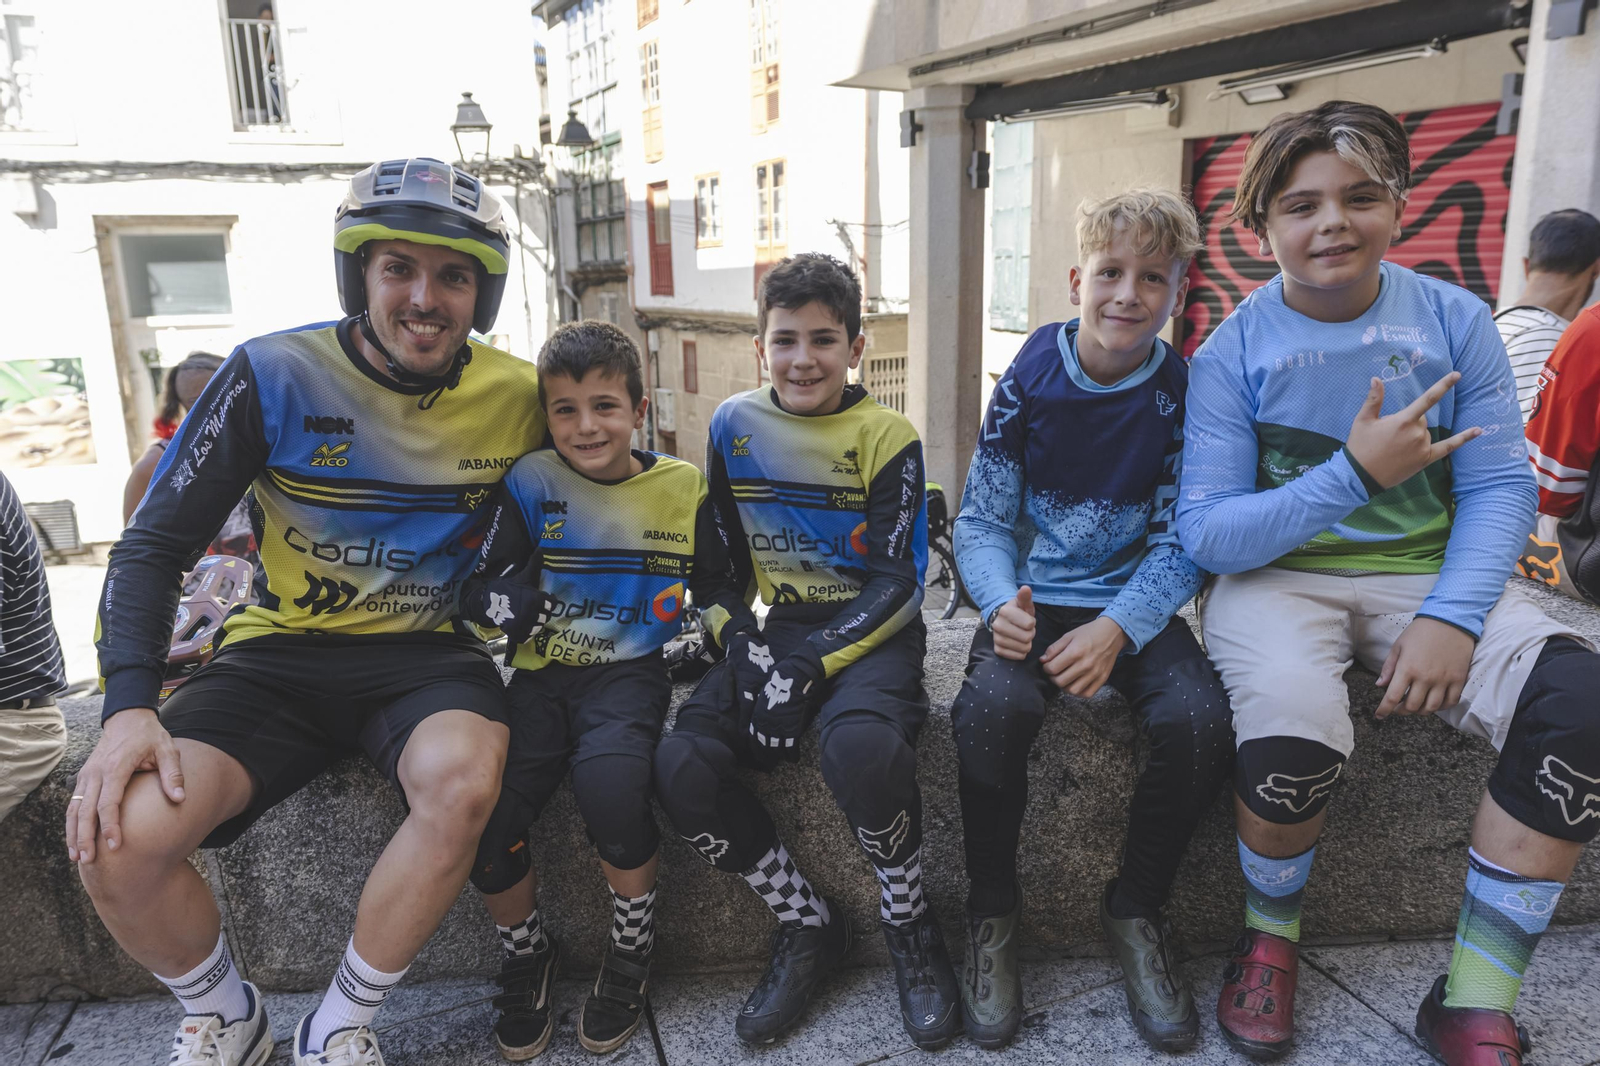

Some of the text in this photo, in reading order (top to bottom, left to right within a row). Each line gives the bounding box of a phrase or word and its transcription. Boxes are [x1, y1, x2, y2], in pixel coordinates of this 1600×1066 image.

[193, 440, 213, 467] Los
[310, 457, 349, 467] ZICO
[732, 448, 749, 456] ZICO
[551, 598, 653, 626] odisoil
[557, 628, 616, 654] XUNTA
[551, 643, 575, 662] DE
